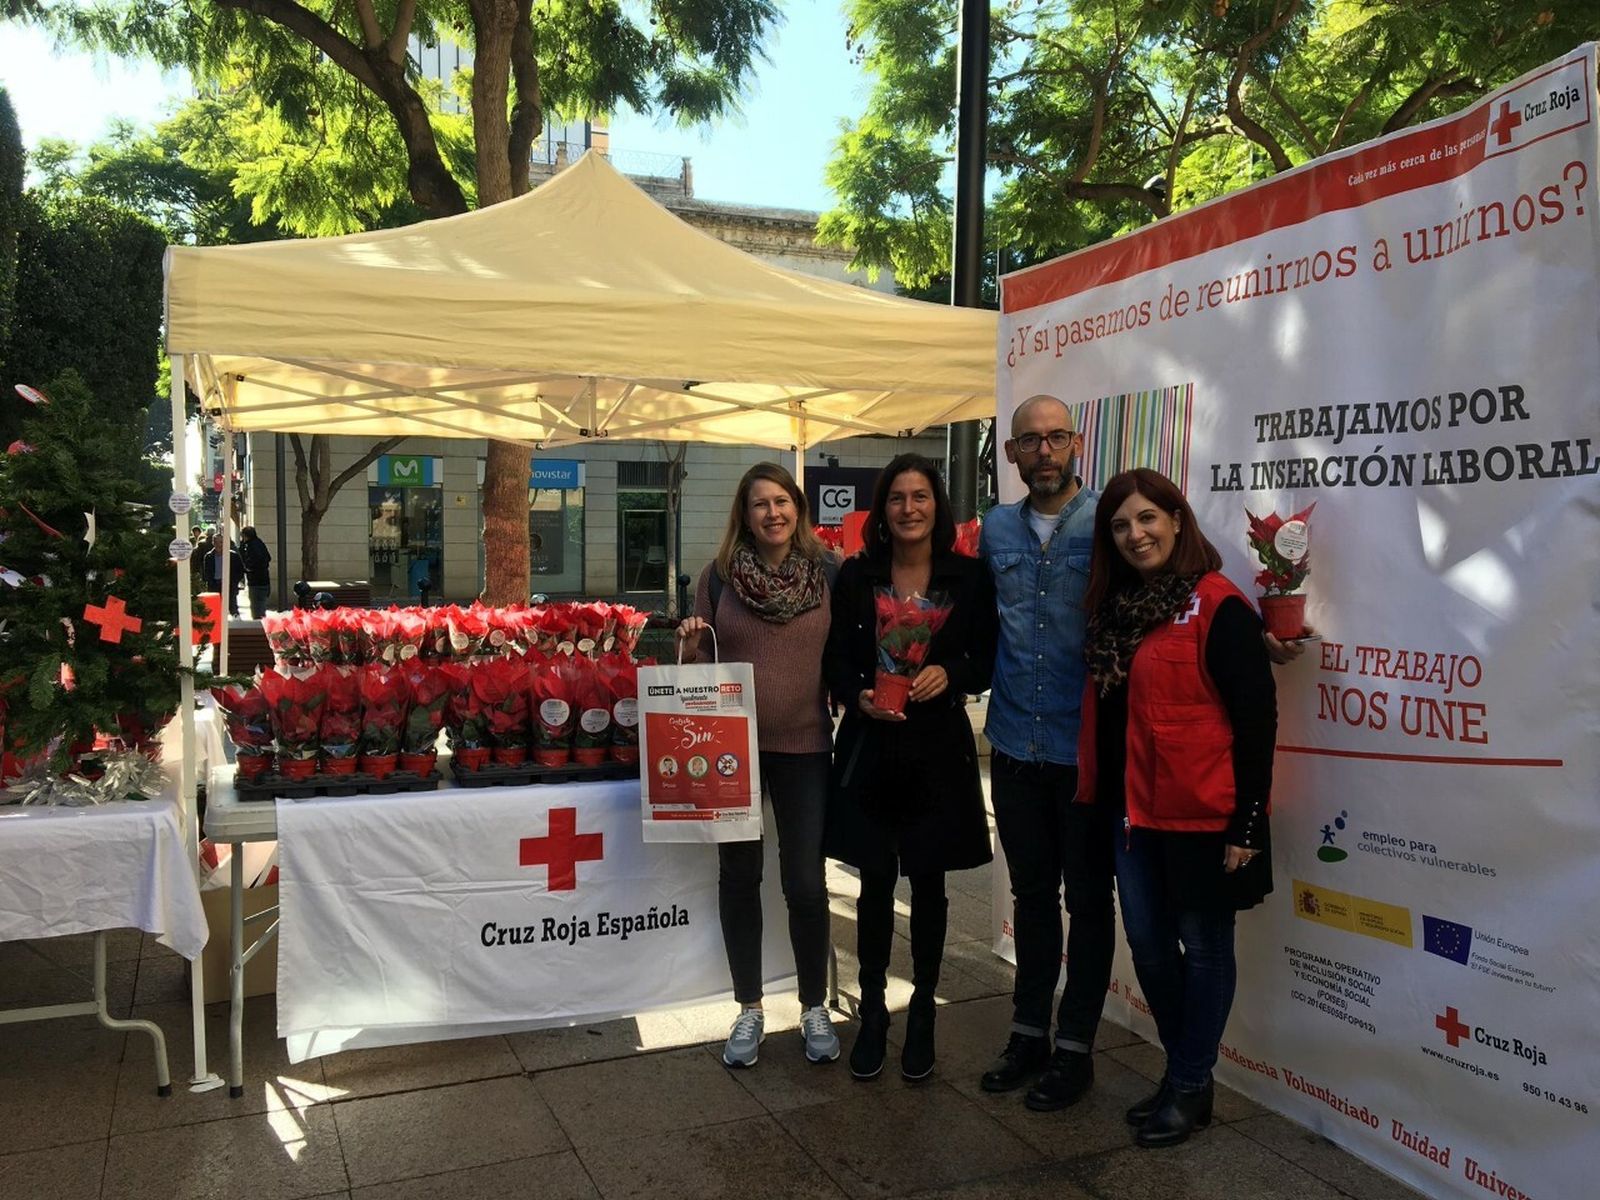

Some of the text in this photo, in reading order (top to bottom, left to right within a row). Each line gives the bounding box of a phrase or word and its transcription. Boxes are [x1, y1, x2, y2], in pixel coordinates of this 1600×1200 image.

[1524, 85, 1581, 122] Cruz Roja
[1364, 169, 1378, 180] vez
[1380, 161, 1396, 176] más
[1400, 154, 1425, 169] cerca
[1429, 149, 1441, 161] de
[1445, 144, 1458, 157] las
[1007, 160, 1588, 368] ¿Y si pasamos de reunirnos a unirnos?
[1254, 384, 1530, 444] TRABAJAMOS POR
[1210, 438, 1600, 492] LA INSERCIÓN LABORAL
[823, 488, 852, 508] CG
[1319, 642, 1482, 694] EL TRABAJO
[683, 686, 720, 694] NUESTRO
[720, 685, 741, 693] RETO
[1317, 682, 1489, 745] NOS UNE
[680, 721, 715, 749] Sin
[1357, 841, 1497, 878] colectivos vulnerables
[1362, 830, 1437, 854] empleo para
[480, 904, 690, 948] Cruz Roja Española
[1474, 929, 1529, 956] Unión Europea
[1284, 946, 1381, 986] PROGRAMA OPERATIVO
[1289, 958, 1376, 997] DE INCLUSIÓN SOCIAL
[1301, 972, 1343, 994] ECONOMÍA
[1344, 988, 1371, 1008] SOCIAL
[1420, 1045, 1500, 1082] www.cruzroja.es
[1474, 1027, 1548, 1067] Cruz Roja
[1522, 1082, 1588, 1114] 950 10 43 96
[1219, 1043, 1279, 1080] endencia
[1281, 1067, 1380, 1130] Voluntariado
[1391, 1118, 1450, 1169] Unidad
[1464, 1157, 1536, 1200] Univer
